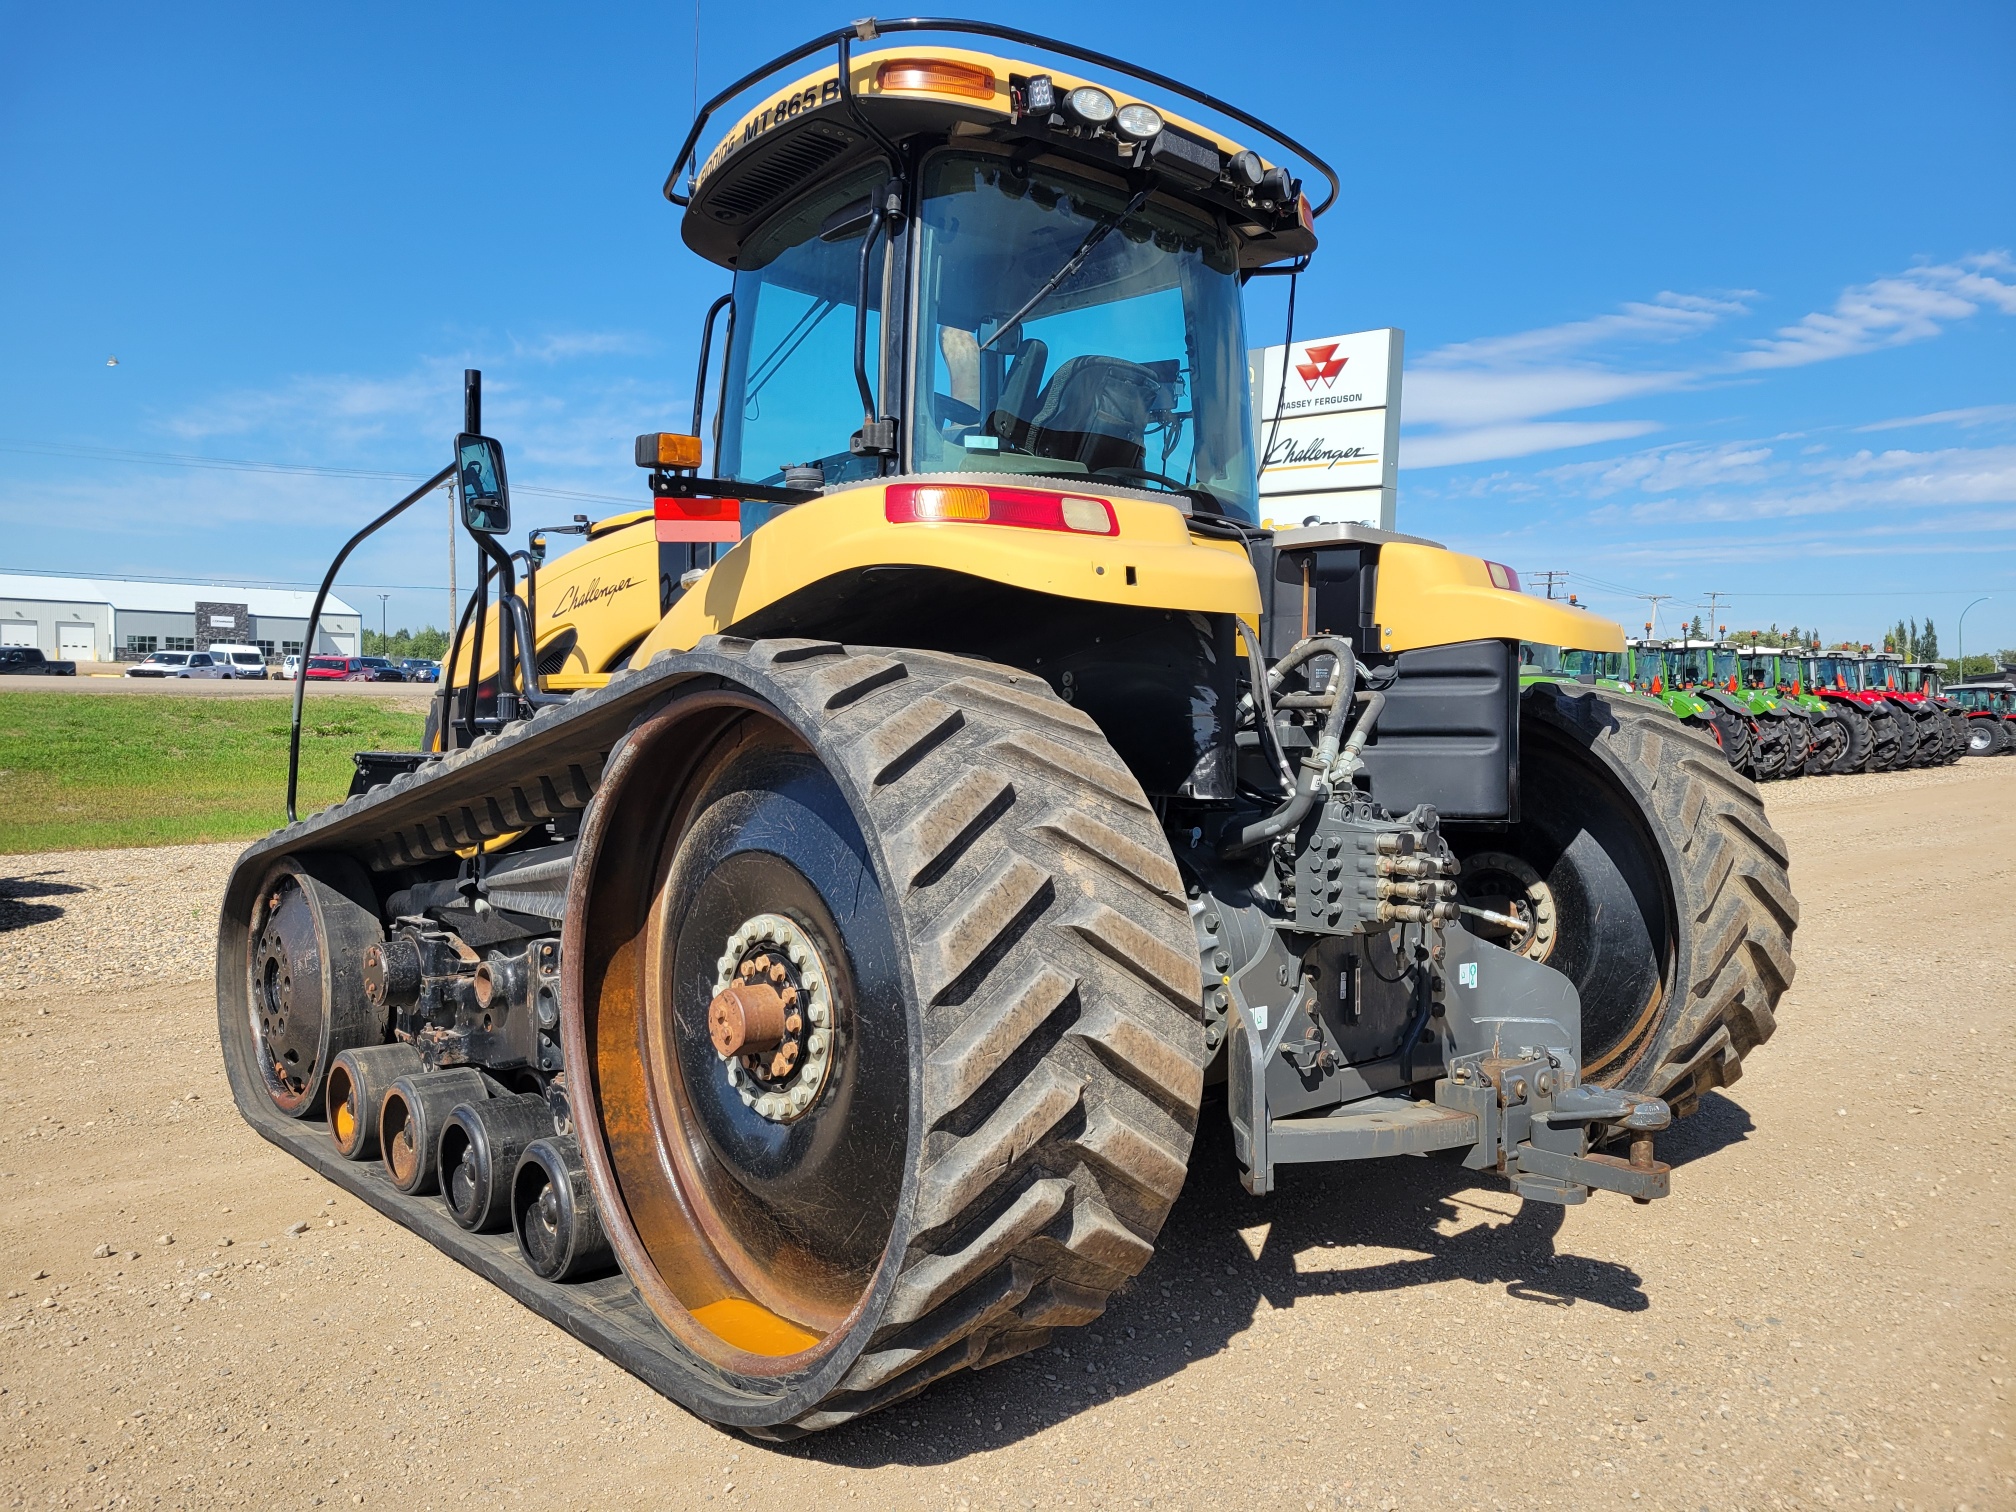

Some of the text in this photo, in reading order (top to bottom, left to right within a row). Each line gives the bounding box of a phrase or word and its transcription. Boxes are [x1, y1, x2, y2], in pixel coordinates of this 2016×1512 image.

[1314, 393, 1363, 406] FERGUSON
[1265, 437, 1379, 470] Challenger
[552, 576, 647, 618] Challenger
